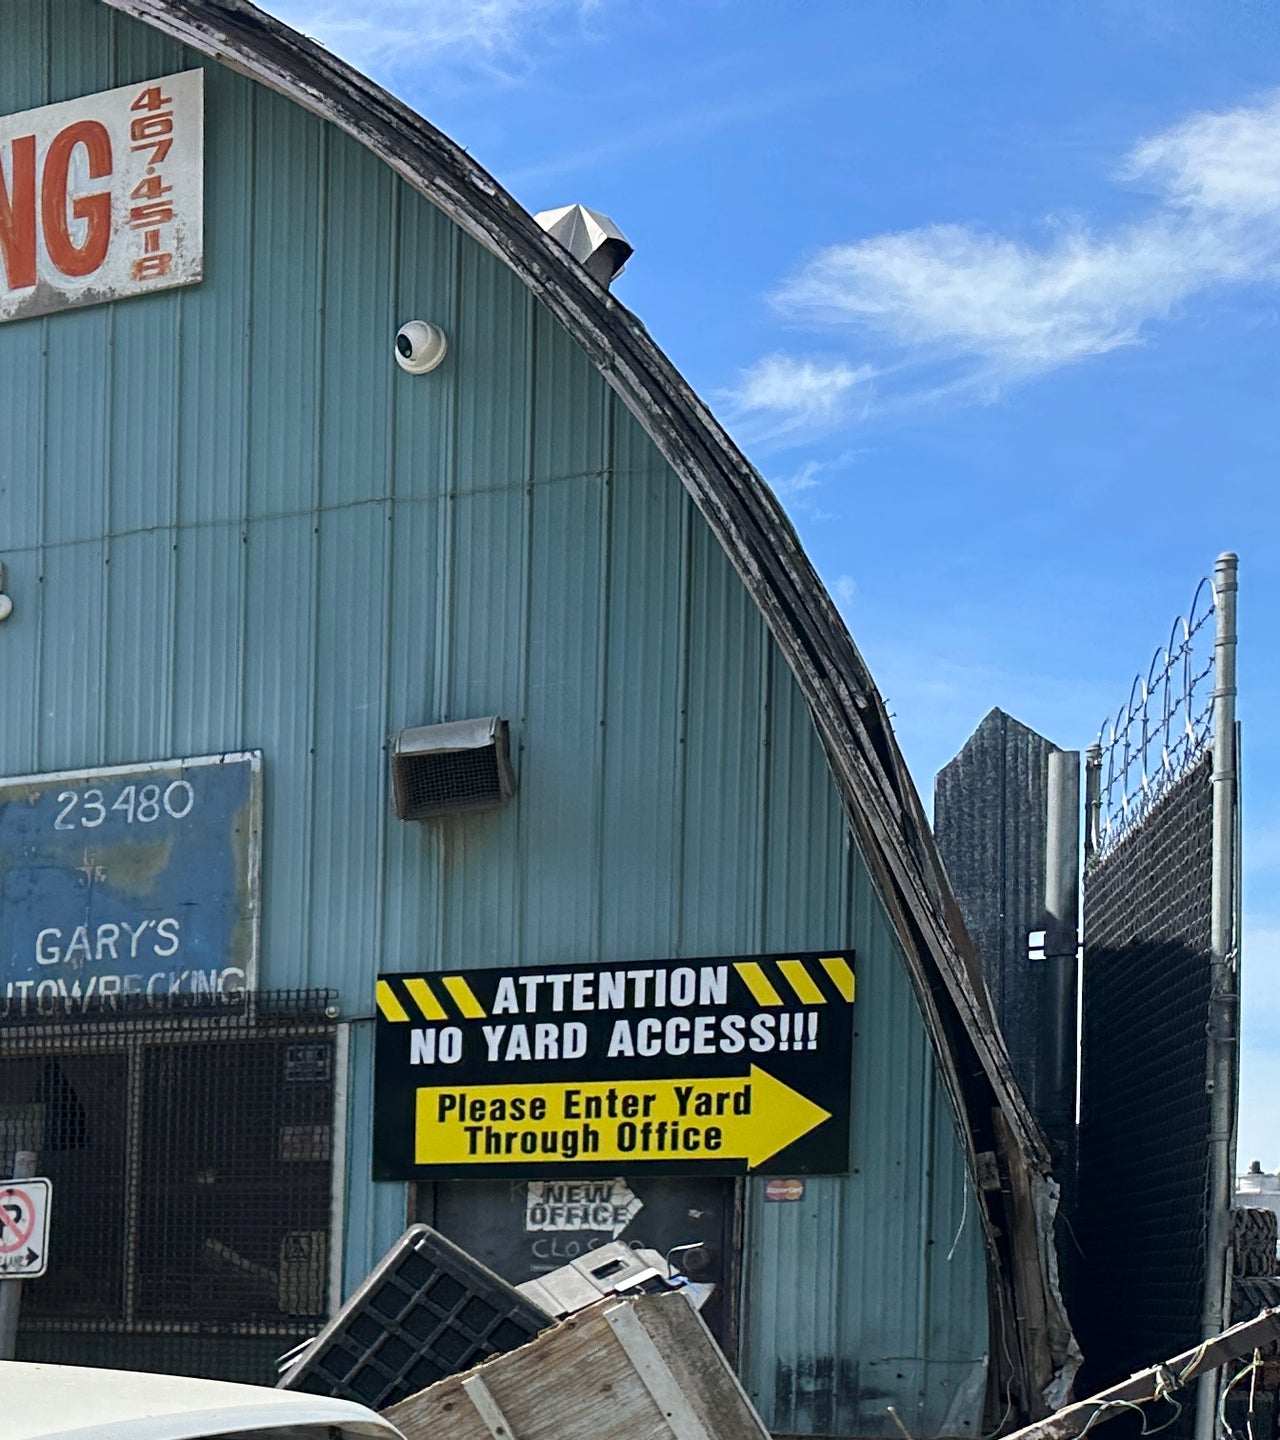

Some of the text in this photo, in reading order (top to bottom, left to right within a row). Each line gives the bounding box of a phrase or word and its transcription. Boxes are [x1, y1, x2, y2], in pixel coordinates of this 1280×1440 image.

[53, 780, 194, 831] 23480
[35, 916, 180, 966] GARY'S
[492, 965, 728, 1015] ATTENTION
[410, 1011, 819, 1065] NO YARD ACCESS!!!
[438, 1084, 752, 1123] Please Enter Yard
[464, 1118, 722, 1159] Through Office
[543, 1180, 615, 1202] NEW
[529, 1203, 629, 1226] OFFICE
[532, 1237, 645, 1259] CLO
